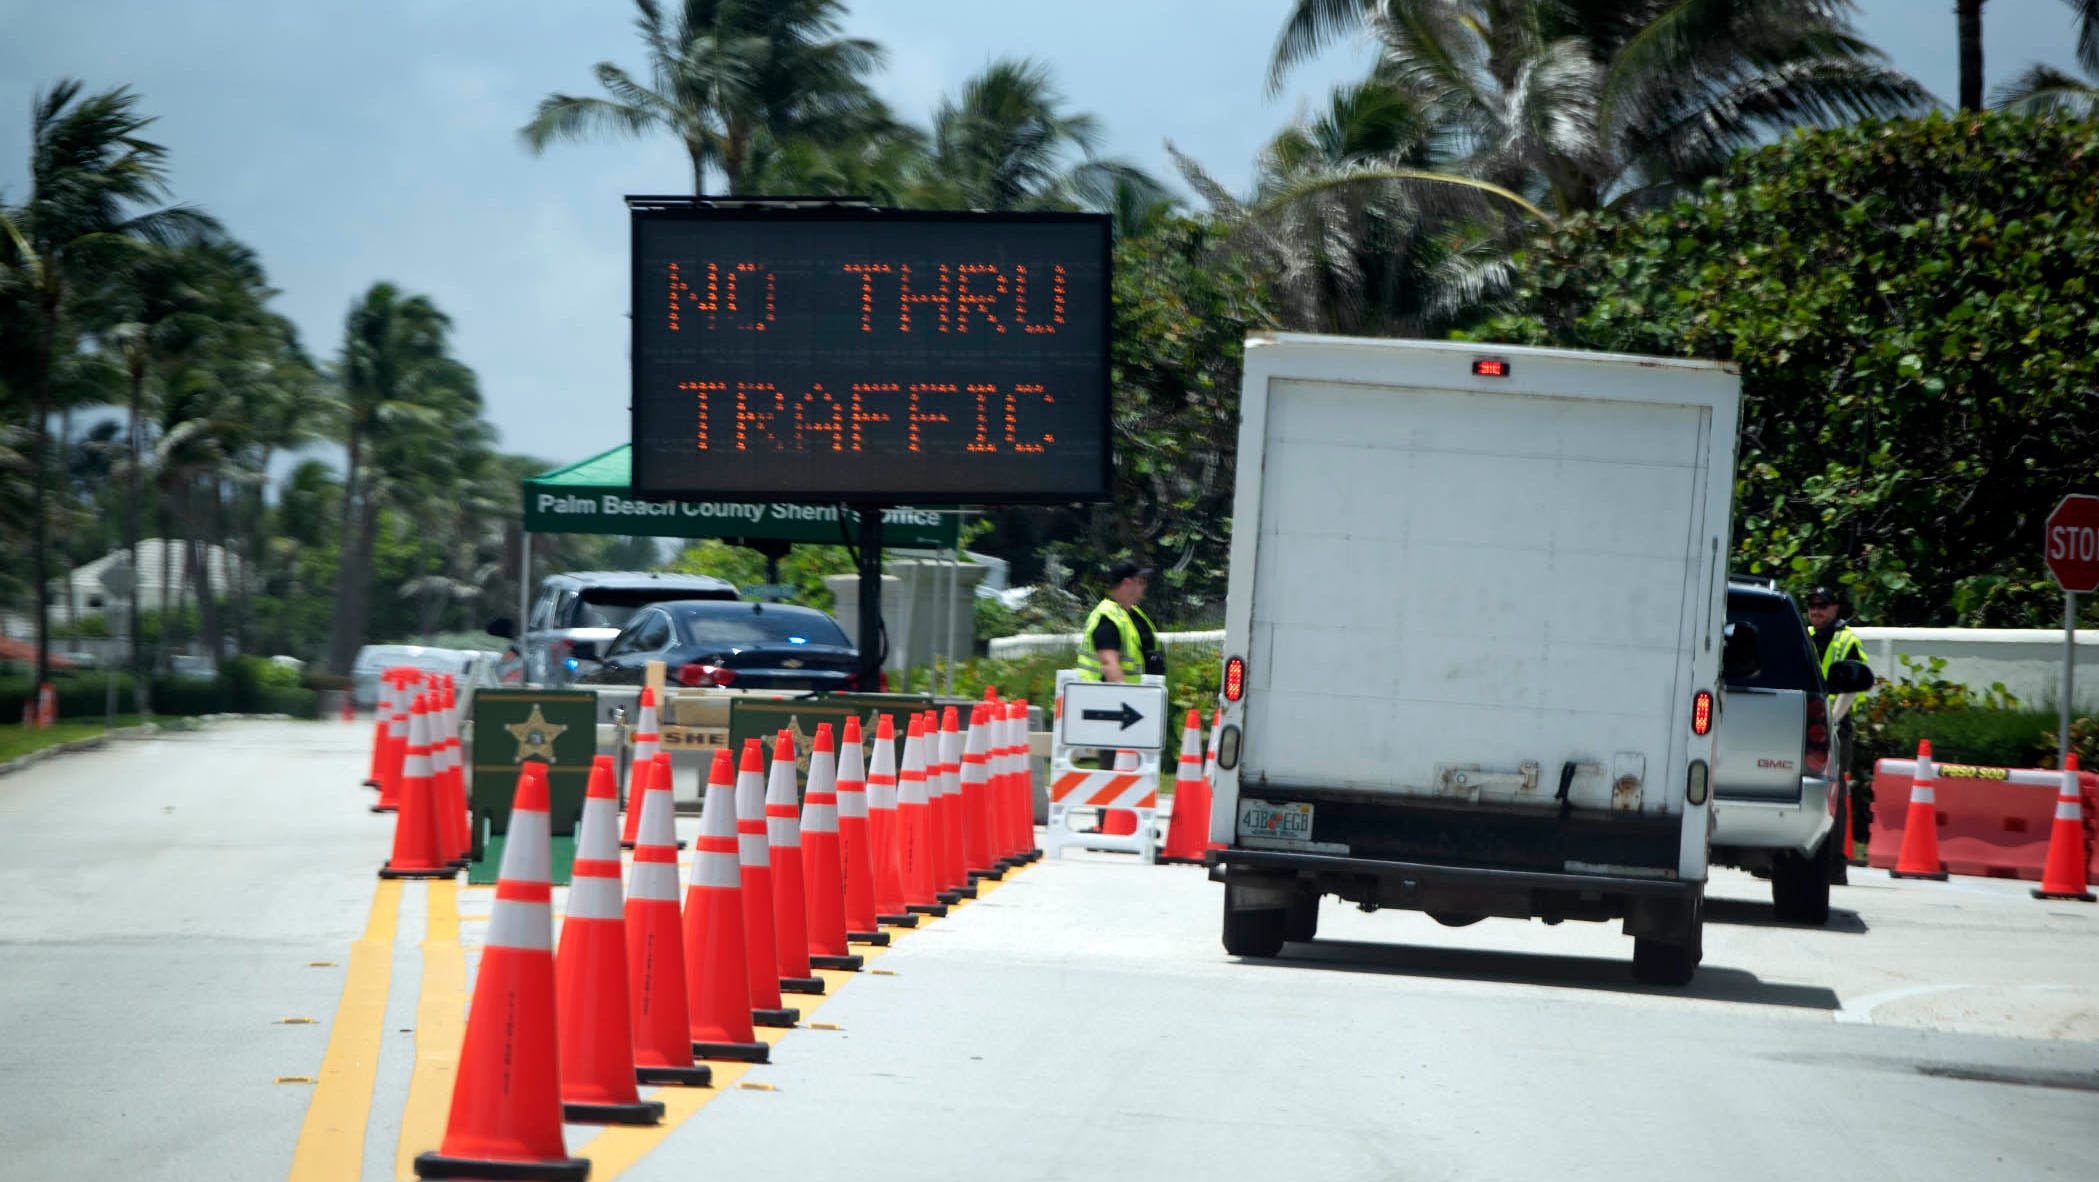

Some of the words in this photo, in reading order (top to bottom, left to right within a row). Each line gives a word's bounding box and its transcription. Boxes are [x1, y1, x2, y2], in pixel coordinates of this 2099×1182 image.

[668, 262, 776, 331] NO
[842, 263, 1067, 334] THRU
[677, 382, 1056, 452] TRAFFIC
[537, 493, 597, 515] Palm
[602, 495, 676, 516] Beach
[682, 501, 765, 523] County
[2050, 525, 2099, 561] STO
[664, 732, 726, 744] SHE
[1757, 758, 1794, 769] GMC
